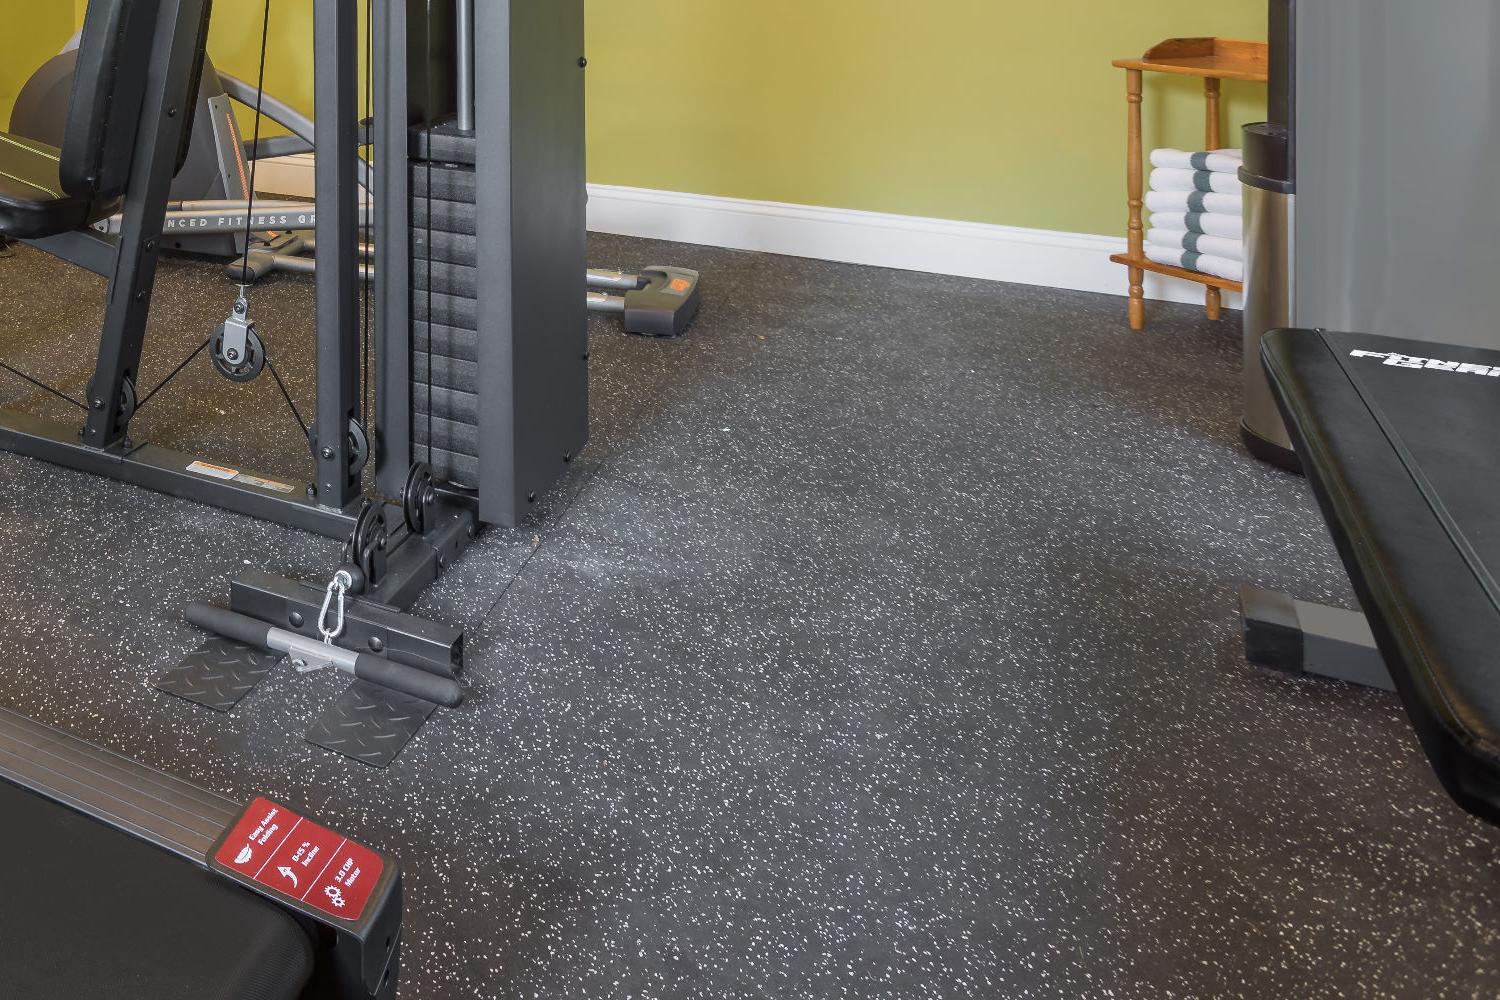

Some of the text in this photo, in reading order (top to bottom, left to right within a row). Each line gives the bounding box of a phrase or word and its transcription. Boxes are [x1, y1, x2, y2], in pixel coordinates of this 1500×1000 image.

[167, 214, 316, 228] NCED FITNESS GR
[249, 808, 278, 841] Easy Assist
[258, 823, 279, 845] Folding
[301, 846, 320, 867] Incline
[344, 867, 360, 887] Motor
